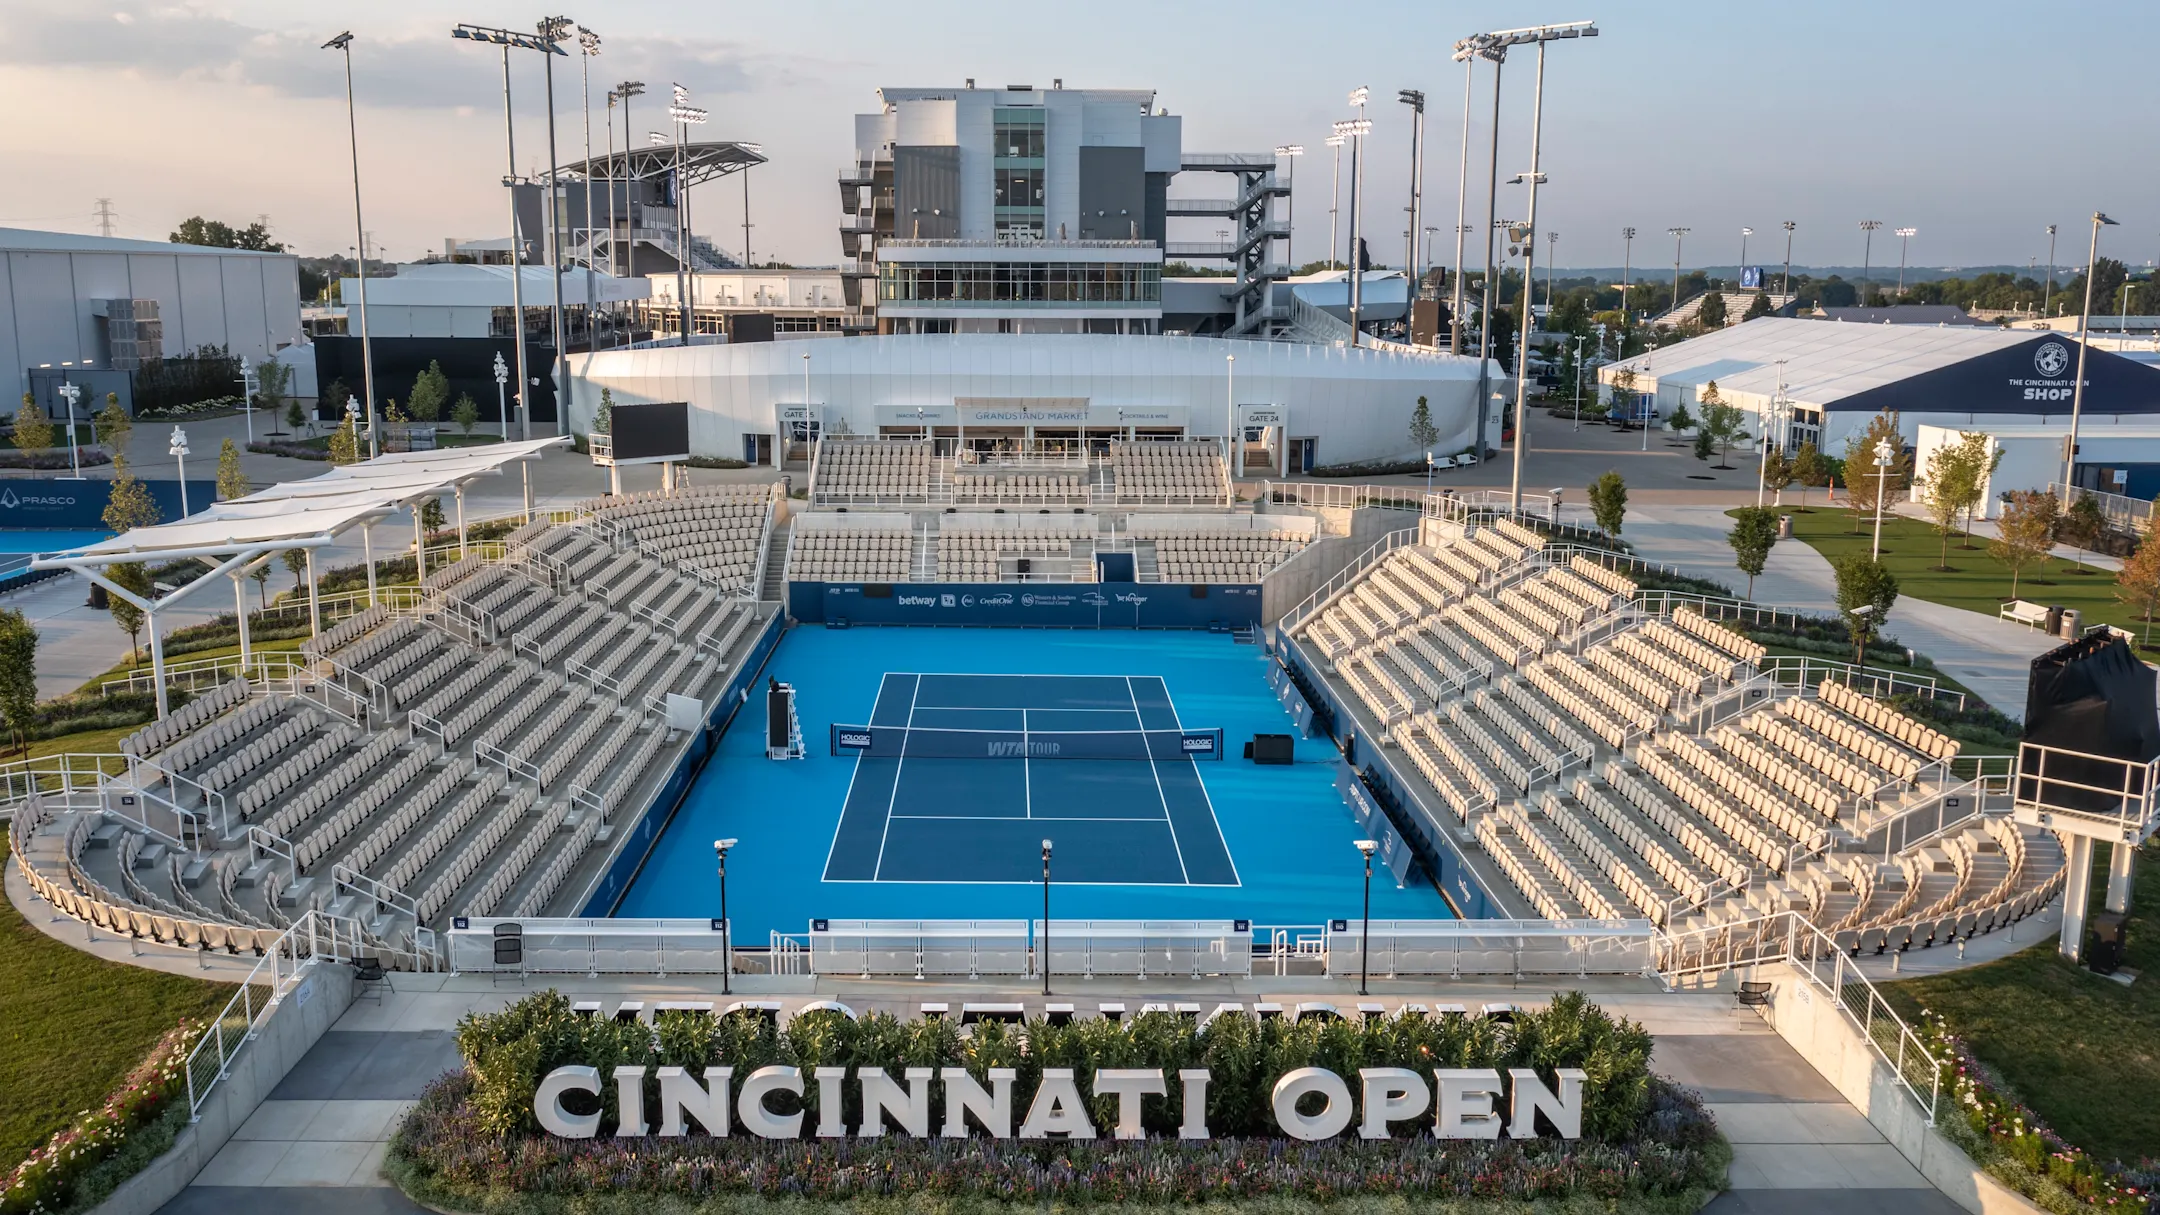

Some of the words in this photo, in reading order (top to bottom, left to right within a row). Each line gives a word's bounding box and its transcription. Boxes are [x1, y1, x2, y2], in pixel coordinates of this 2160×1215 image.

[2024, 379, 2068, 387] CINCINNATI
[2023, 388, 2073, 401] SHOP
[975, 411, 1045, 420] GRANDSTAND
[1047, 412, 1089, 420] MARKET
[22, 496, 76, 505] PRASCO
[898, 595, 937, 608] betway
[1126, 593, 1148, 606] Kroger
[841, 733, 871, 742] HOLOGIC
[988, 741, 1025, 756] WTA
[1028, 742, 1061, 756] TOUR
[534, 1065, 1212, 1139] CINCINNATI
[1272, 1067, 1589, 1141] OPEN
